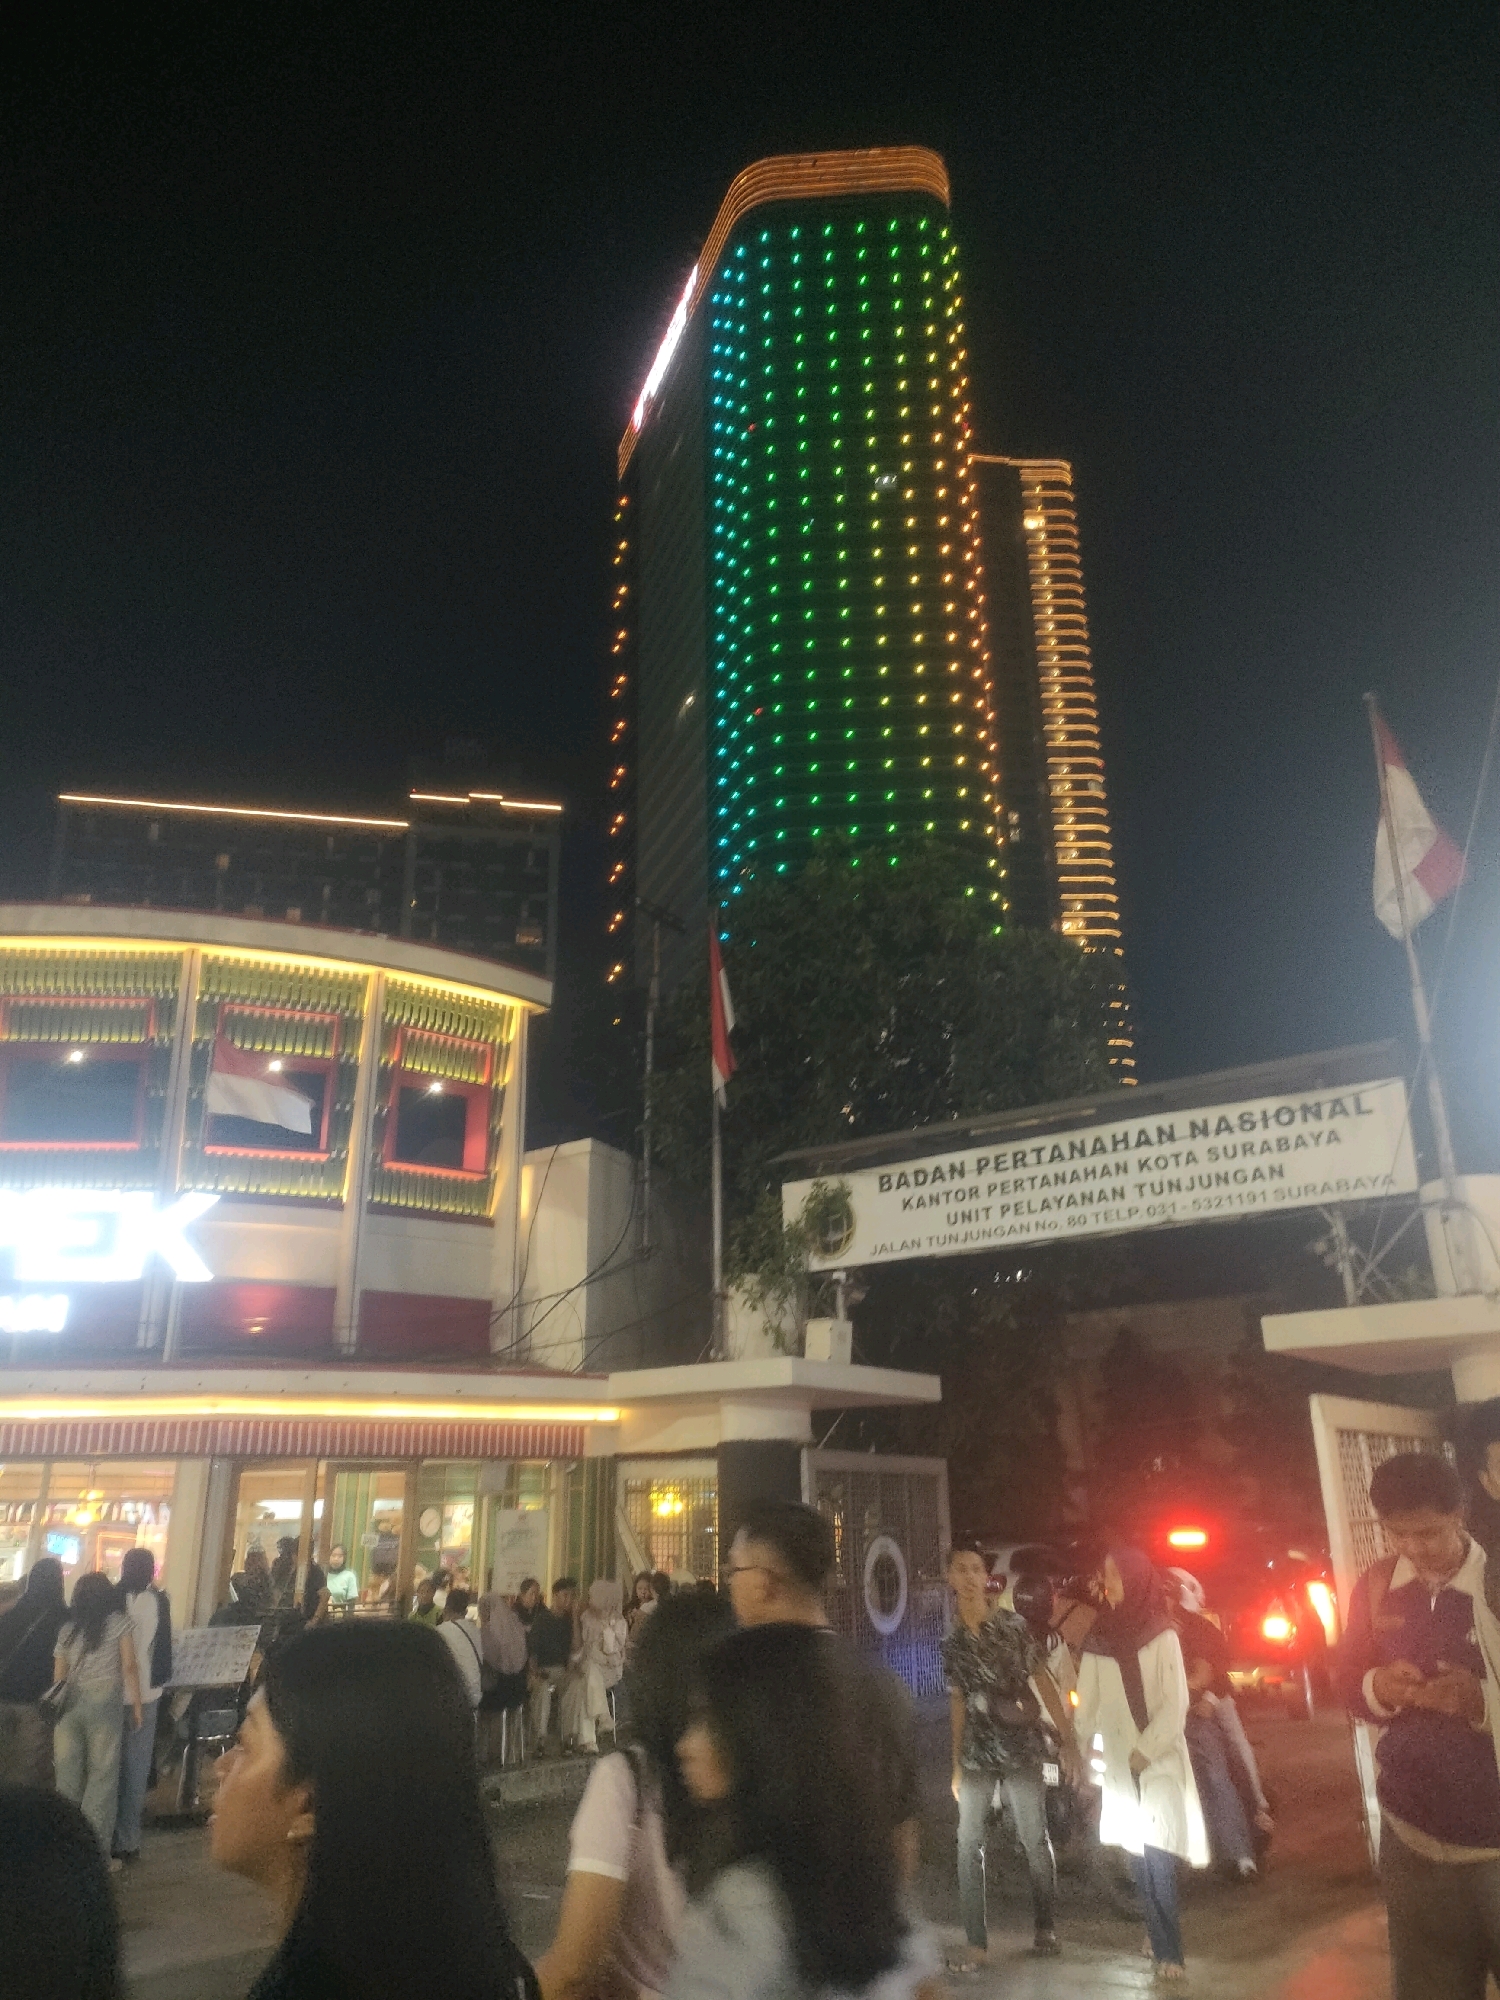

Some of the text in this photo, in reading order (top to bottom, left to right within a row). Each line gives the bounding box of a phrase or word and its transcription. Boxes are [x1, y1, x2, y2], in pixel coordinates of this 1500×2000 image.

[878, 1093, 1374, 1193] BADAN PERTANAHAN NASIONAL
[902, 1129, 1342, 1212] KANTOR PERTANAHAN KOTA SURABAYA
[869, 1238, 922, 1257] JALAN
[925, 1221, 1031, 1248] TUNJUNGAN
[1273, 1173, 1396, 1203] SURABAYA
[946, 1163, 1285, 1227] UNIT PELAYANAN TUNJUNGAN
